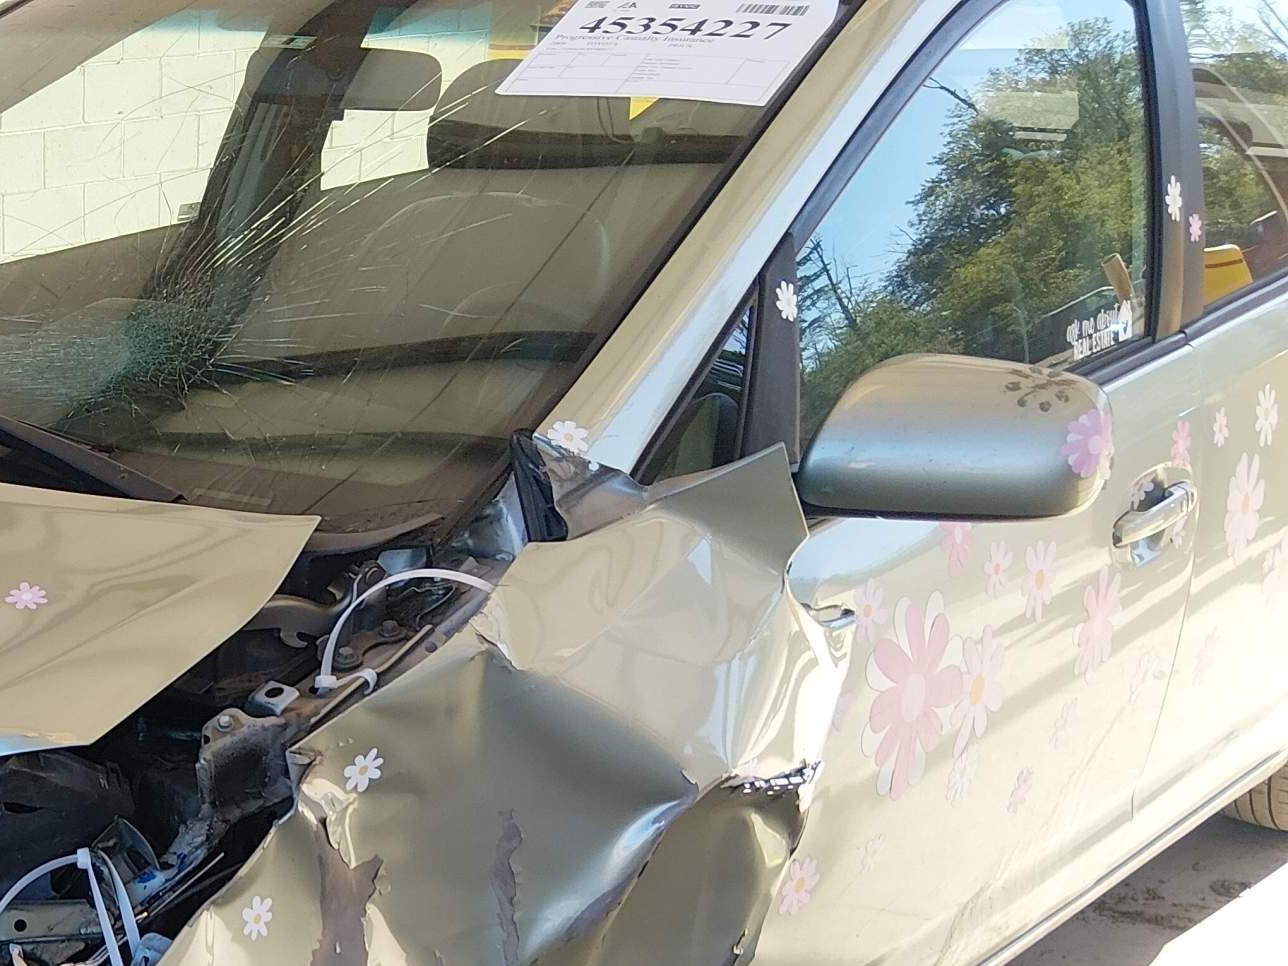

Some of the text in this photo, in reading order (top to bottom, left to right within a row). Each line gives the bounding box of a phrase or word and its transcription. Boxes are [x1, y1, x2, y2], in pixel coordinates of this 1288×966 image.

[555, 34, 715, 44] Progressive Casualty Insurance
[579, 16, 792, 39] 45354227
[1073, 327, 1115, 360] REAL ESTATE
